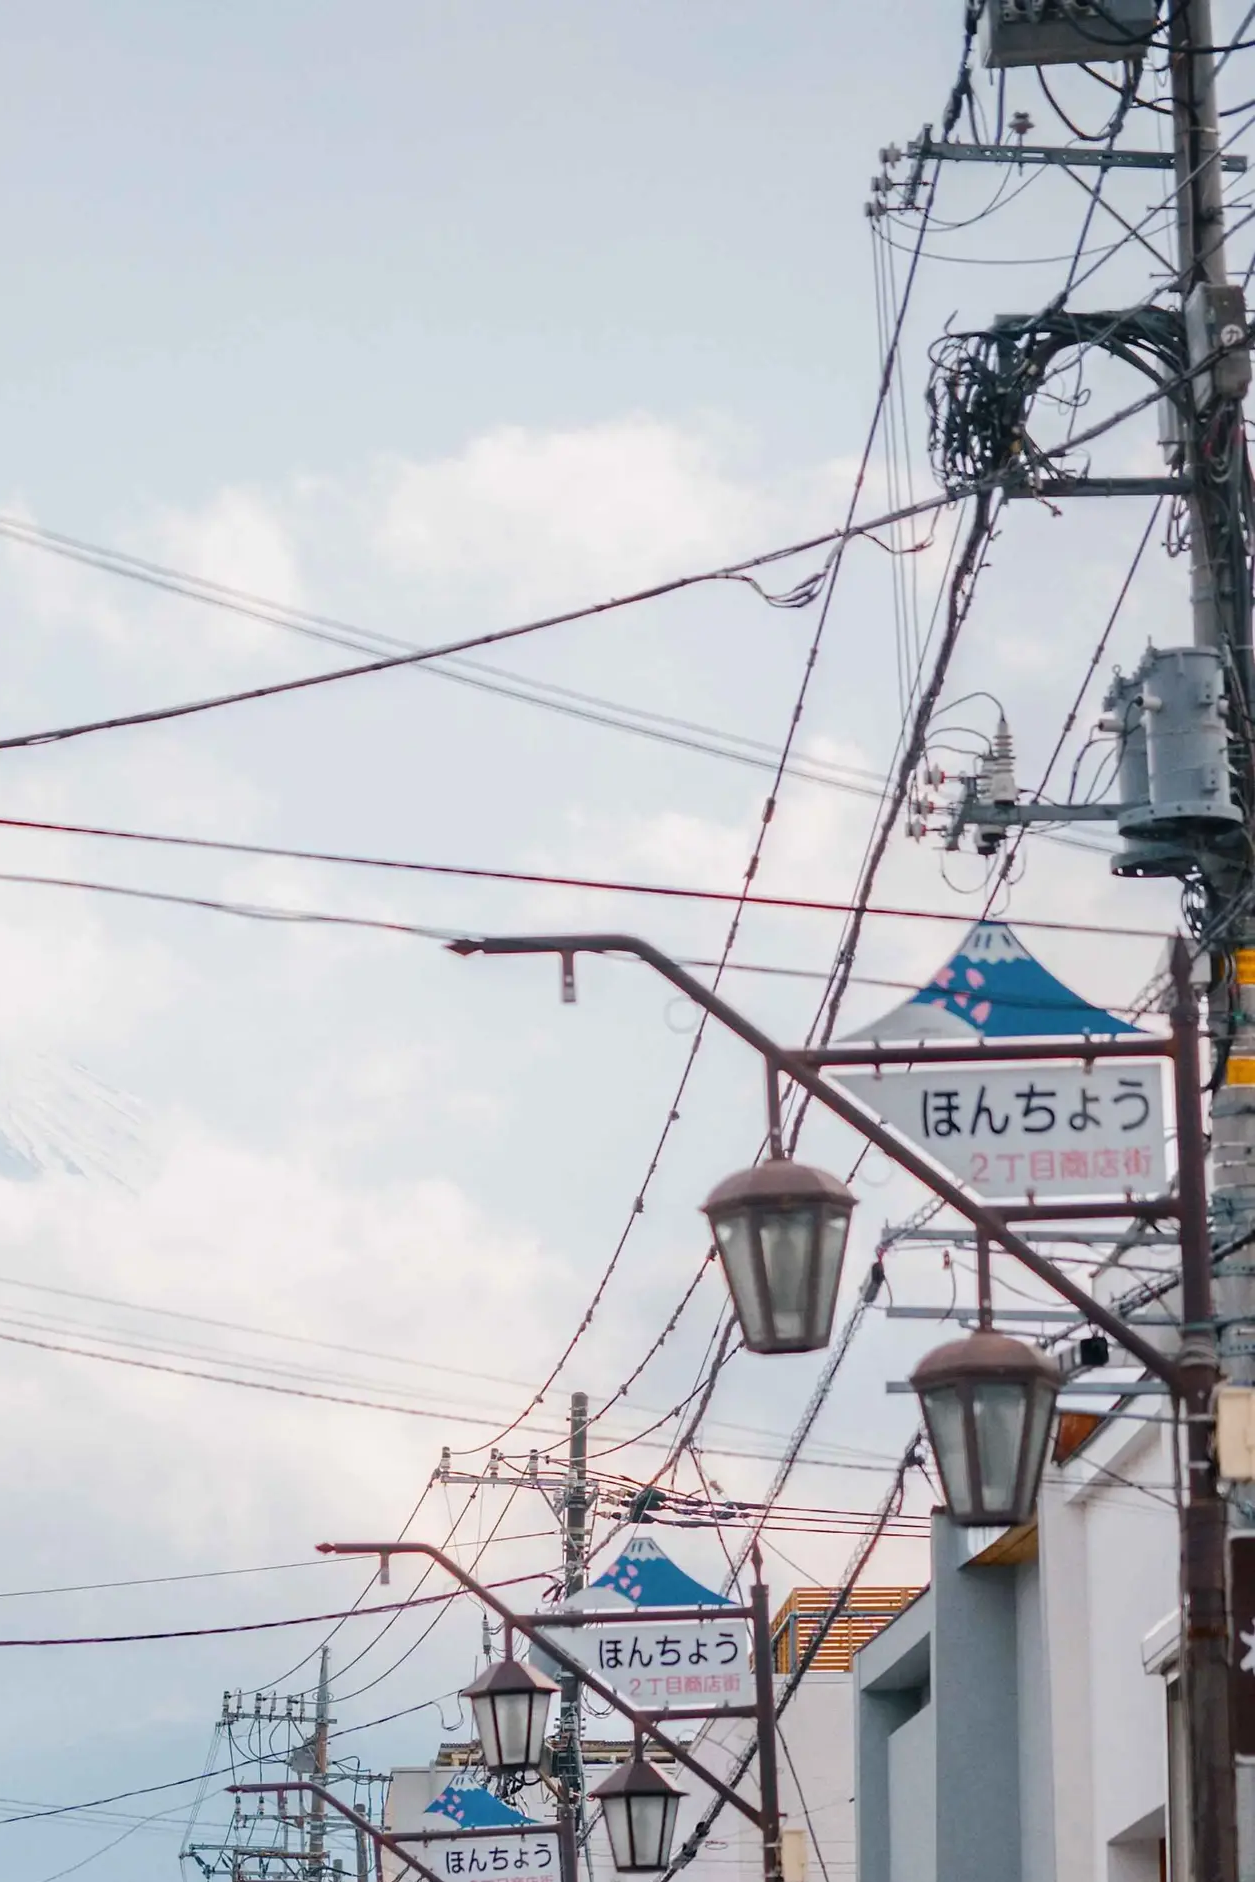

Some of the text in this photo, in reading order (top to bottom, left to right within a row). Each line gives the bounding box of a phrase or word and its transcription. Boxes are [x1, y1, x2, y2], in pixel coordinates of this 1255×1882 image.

[920, 1077, 1151, 1138] ほんちょう
[968, 1144, 1152, 1184] 2丁目商店街
[597, 1630, 740, 1671] ほんちょう
[628, 1673, 742, 1697] 2丁目商店街
[445, 1842, 553, 1874] ほんちょう
